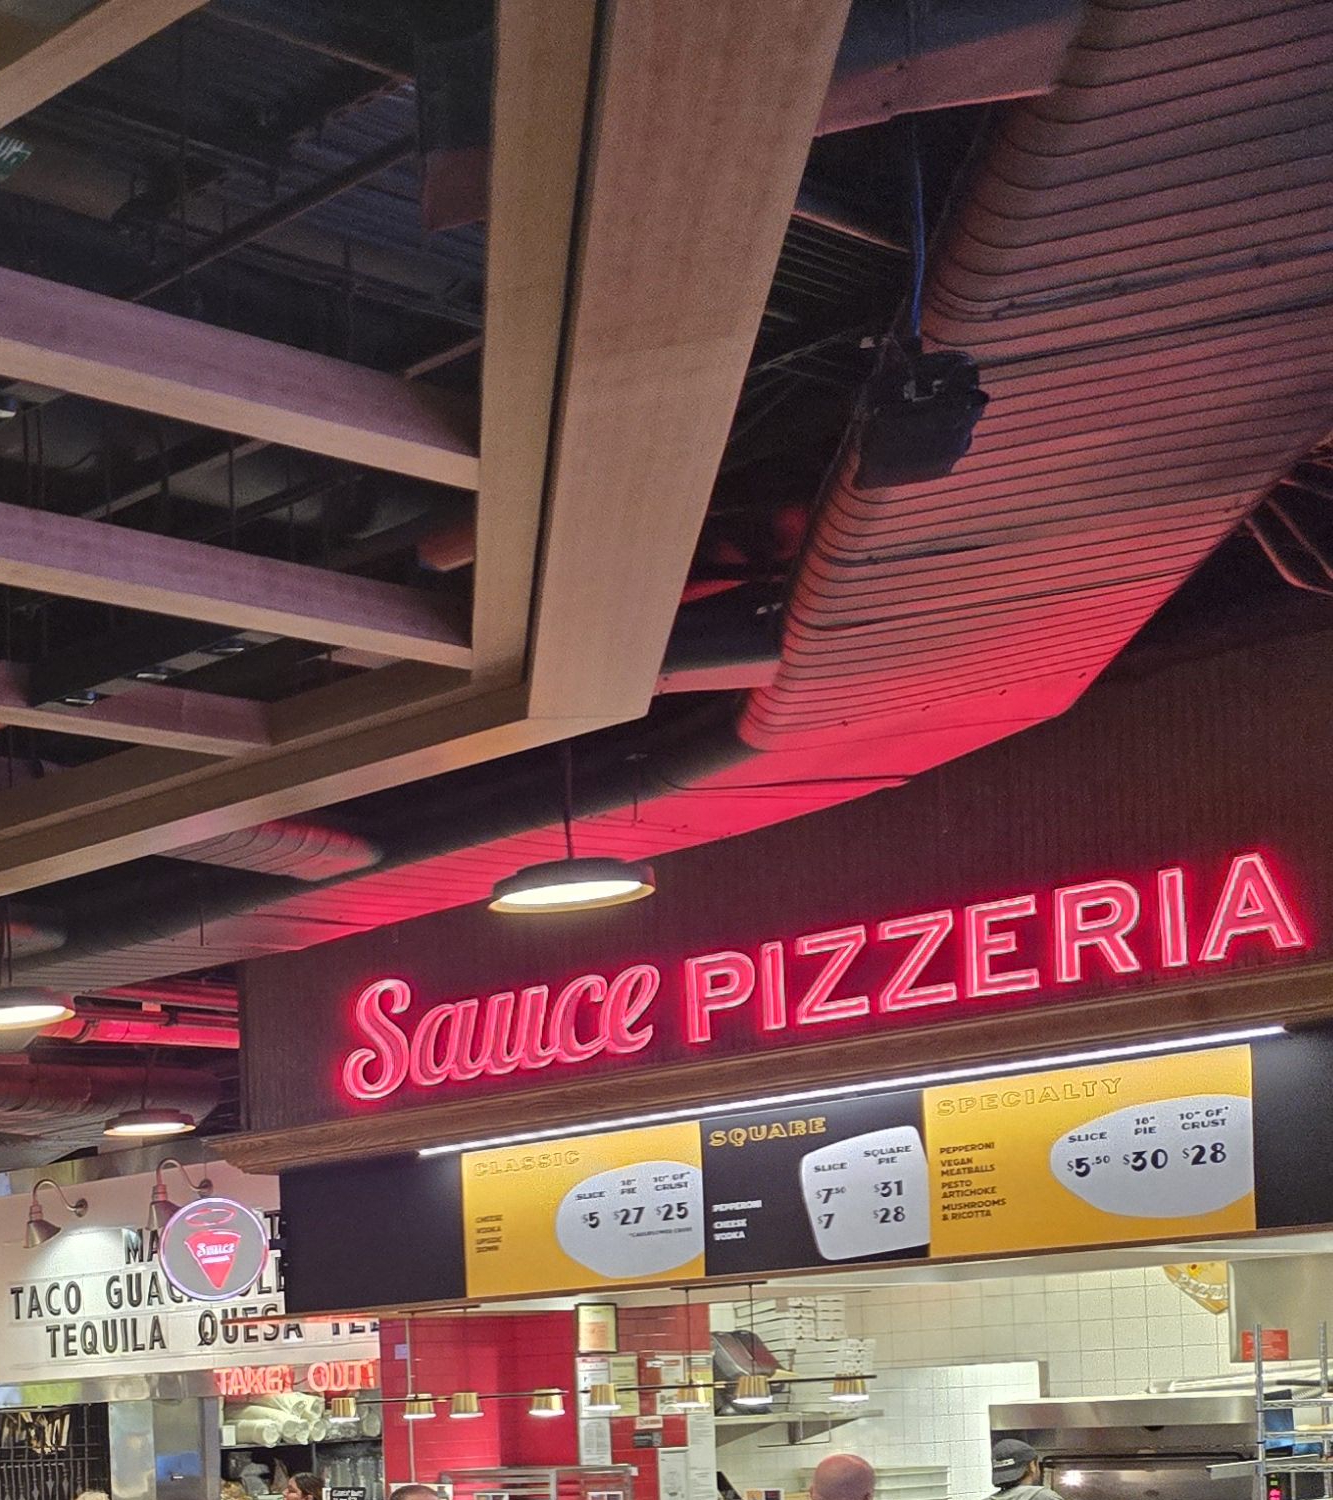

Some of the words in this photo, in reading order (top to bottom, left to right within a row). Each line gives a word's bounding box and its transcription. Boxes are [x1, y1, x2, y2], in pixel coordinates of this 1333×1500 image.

[342, 964, 661, 1100] Sauce
[685, 851, 1304, 1044] PIZZERIA
[936, 1076, 1122, 1116] SPECIALTY
[709, 1117, 827, 1147] SQUARE
[1134, 1126, 1157, 1136] PIE
[1181, 1118, 1227, 1131] CRUST
[1068, 1131, 1108, 1143] SLICE
[863, 1145, 913, 1158] SQUARE
[939, 1142, 995, 1155] PEPPERONI
[1182, 1142, 1227, 1166] $28
[473, 1150, 581, 1177] CLASSIC
[878, 1156, 898, 1166] PIE
[940, 1156, 974, 1167] VEGAN
[1066, 1154, 1111, 1178] $5.50
[1122, 1148, 1168, 1172] $30
[813, 1162, 848, 1174] SLICE
[940, 1163, 996, 1178] MEATBALLS
[655, 1181, 689, 1192] CRUST
[873, 1180, 904, 1198] $31
[941, 1179, 973, 1189] PESTO
[575, 1190, 605, 1201] SLICE
[941, 1186, 997, 1200] ARTICHOKE
[942, 1198, 1007, 1213] MUSHROOMS
[582, 1211, 600, 1229] $5
[613, 1206, 646, 1226] $27
[656, 1201, 689, 1222] $25
[817, 1212, 835, 1230] $7
[873, 1206, 906, 1224] $28
[951, 1209, 992, 1221] RICOTTA
[10, 1281, 82, 1320] TACO
[46, 1314, 167, 1358] TEQUILA
